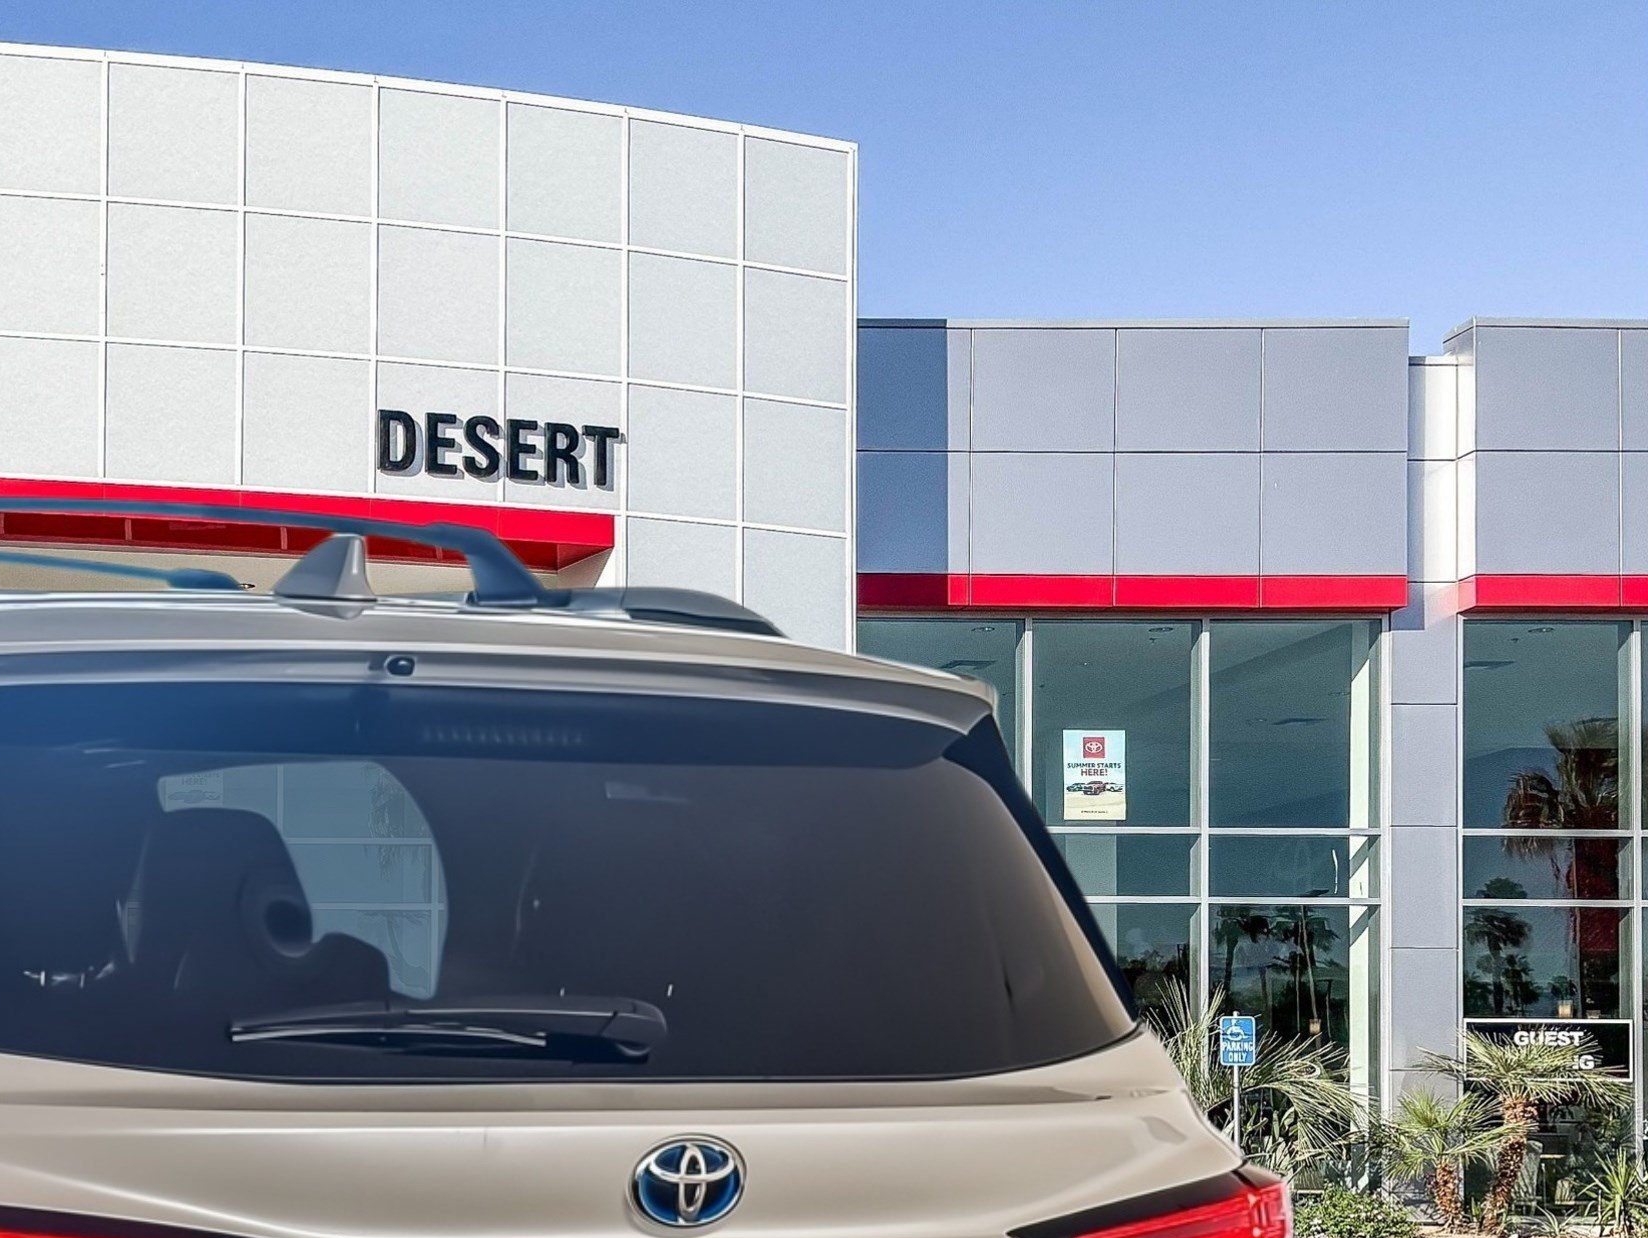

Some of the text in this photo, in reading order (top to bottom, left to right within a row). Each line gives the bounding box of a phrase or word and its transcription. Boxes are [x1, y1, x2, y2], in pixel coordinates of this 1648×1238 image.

[377, 409, 620, 487] DESERT
[1513, 1030, 1584, 1047] GUEST
[1222, 1041, 1253, 1052] PARKING
[1228, 1052, 1248, 1062] ONLY
